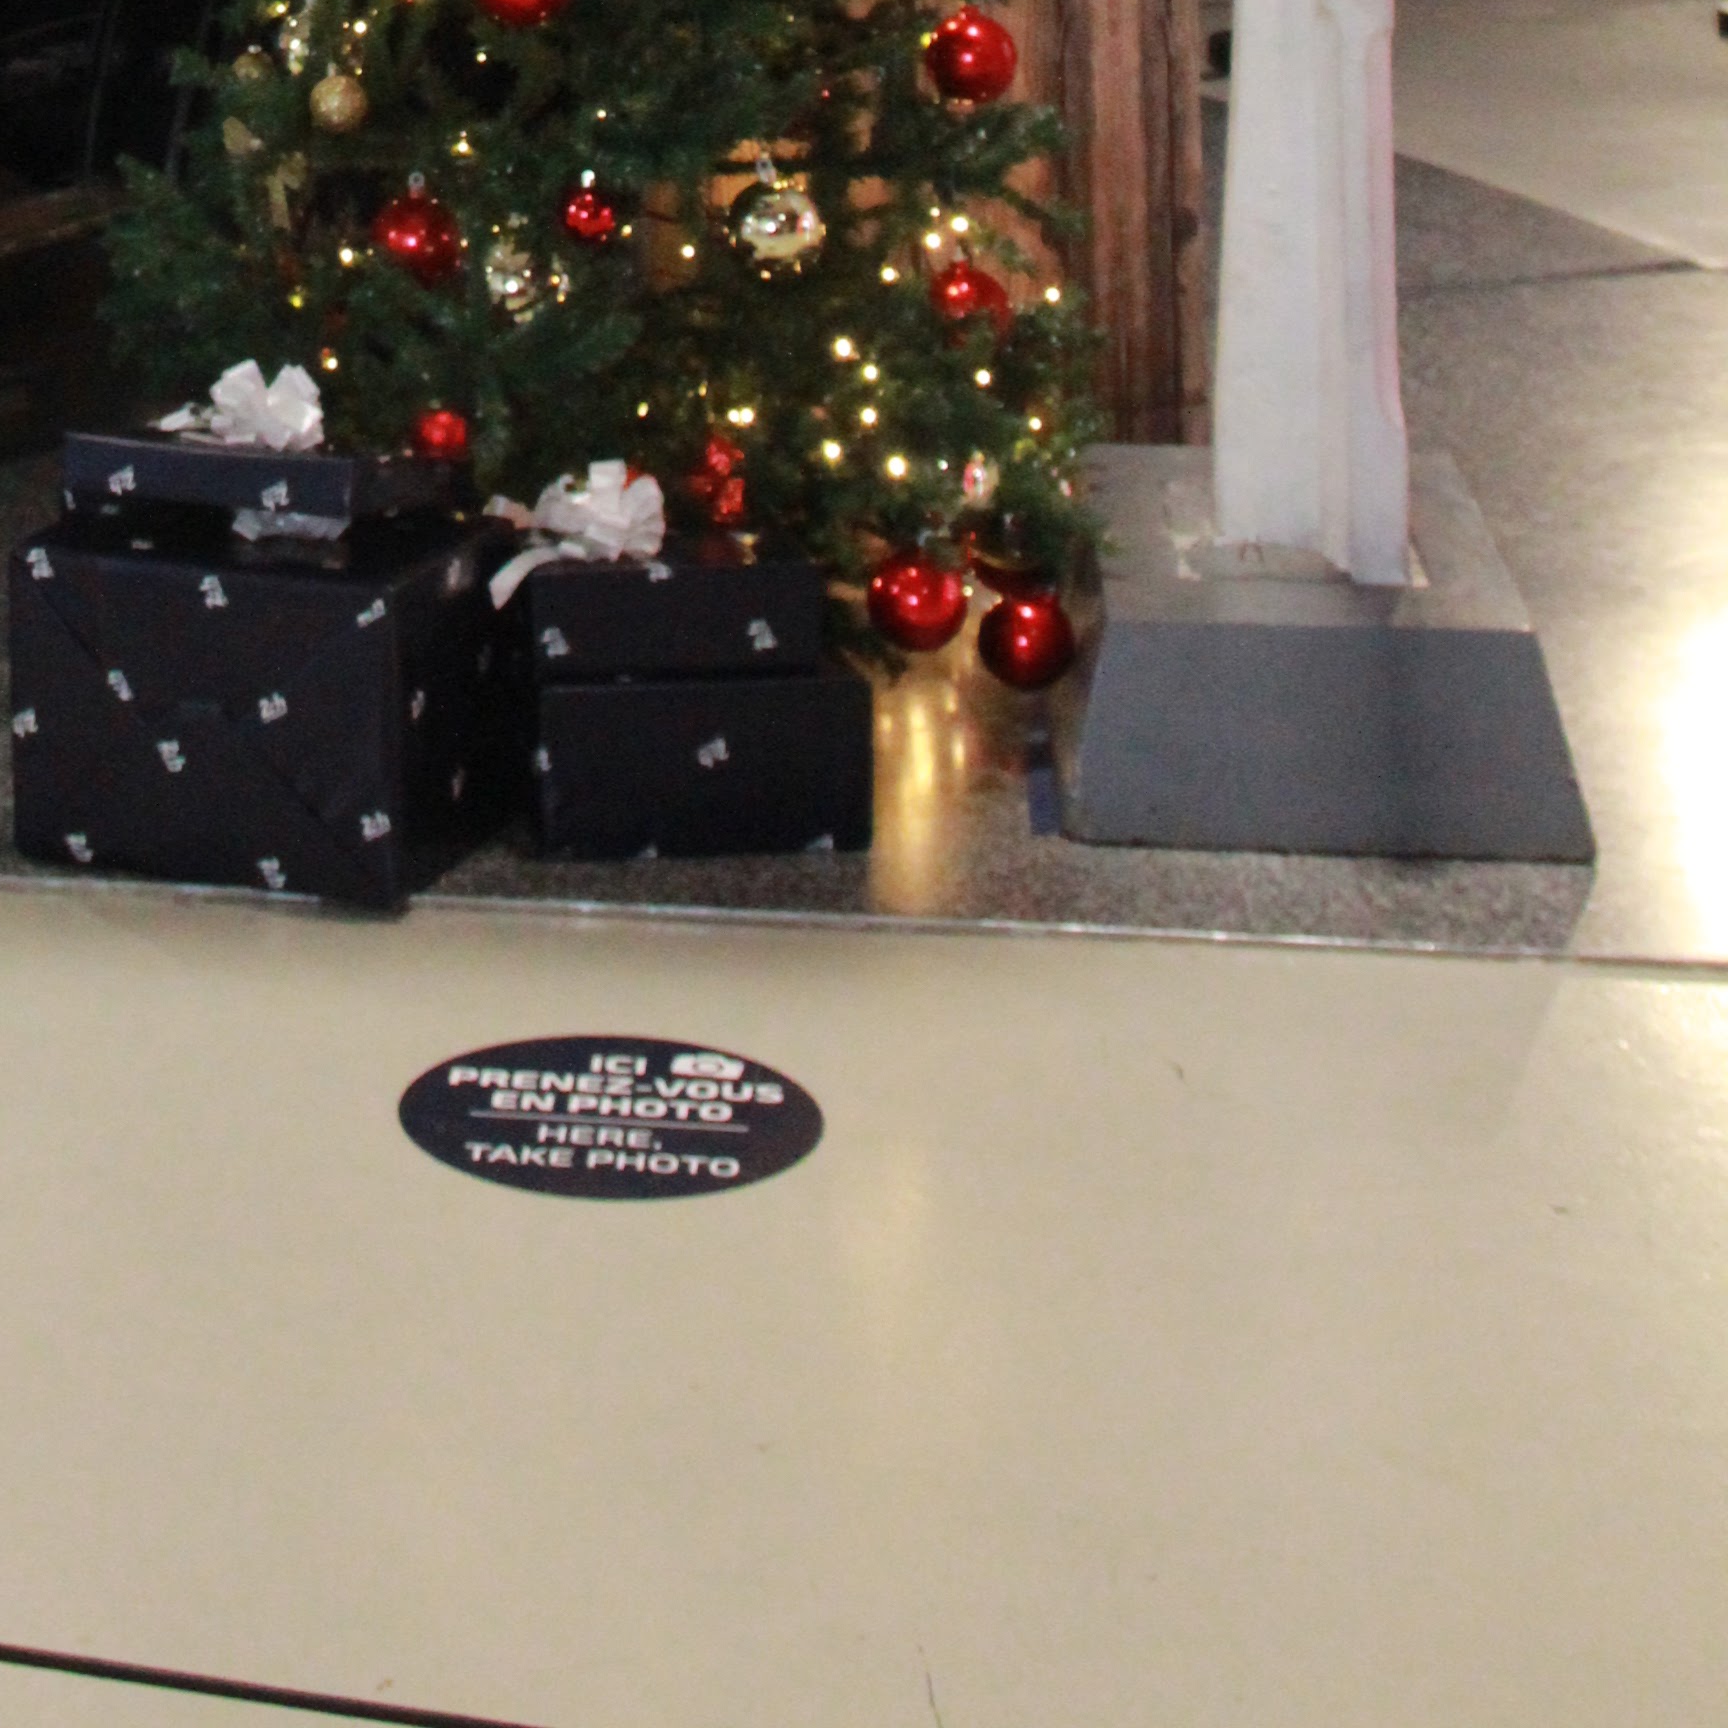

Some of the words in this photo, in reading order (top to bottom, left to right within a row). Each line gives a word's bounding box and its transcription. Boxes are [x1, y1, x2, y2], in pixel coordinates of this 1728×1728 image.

[590, 1053, 647, 1076] ICI
[448, 1066, 784, 1105] PRENEZ-VOUS
[490, 1090, 555, 1113] EN
[567, 1093, 733, 1123] PHOTO
[464, 1142, 573, 1170] TAKE
[587, 1150, 741, 1179] PHOTO
